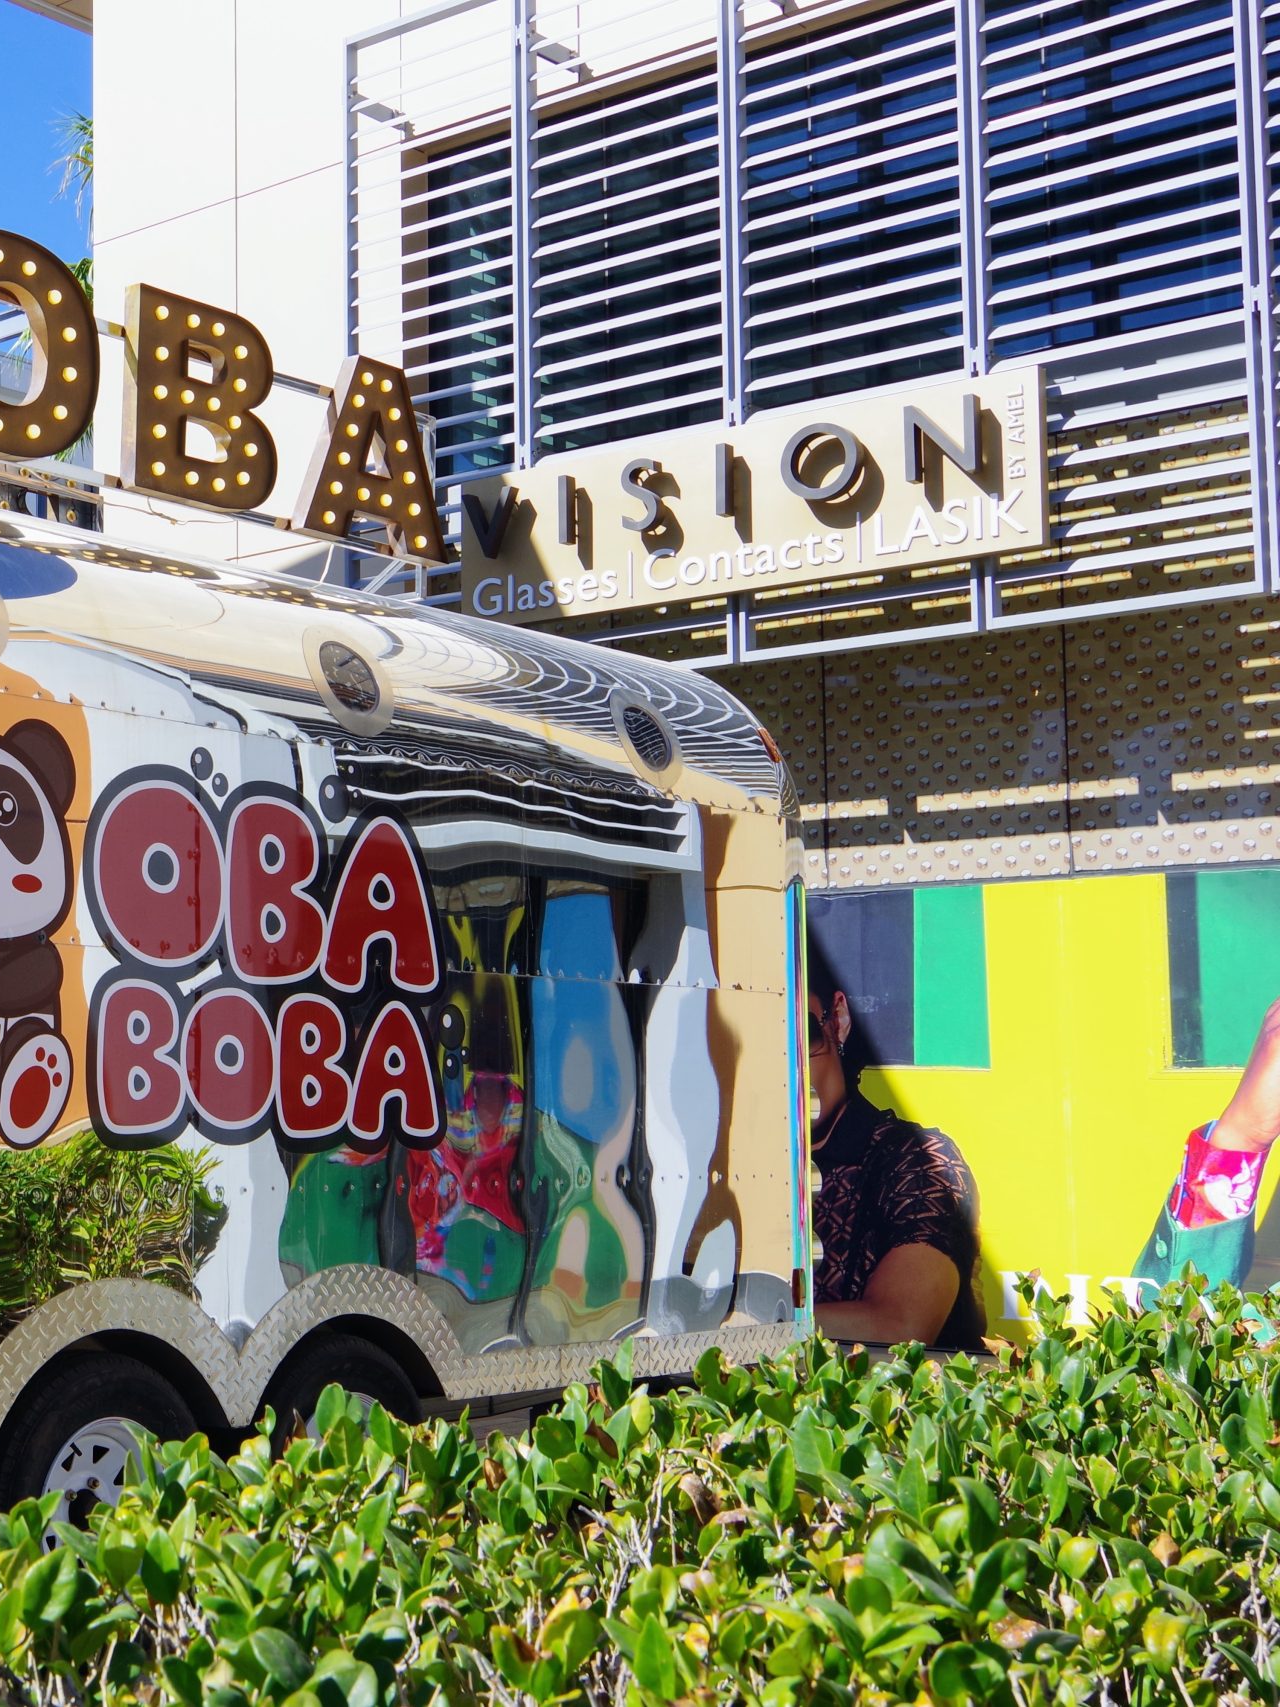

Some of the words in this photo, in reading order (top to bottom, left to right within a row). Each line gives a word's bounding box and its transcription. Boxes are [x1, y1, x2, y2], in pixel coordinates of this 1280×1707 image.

[461, 393, 981, 560] VISION
[1006, 383, 1026, 447] AMEL
[1007, 457, 1026, 480] BY
[472, 569, 620, 617] Glasses
[643, 531, 845, 590] Contacts
[874, 488, 1029, 556] LASIK
[89, 777, 442, 996] OBA
[94, 980, 443, 1141] BOBA
